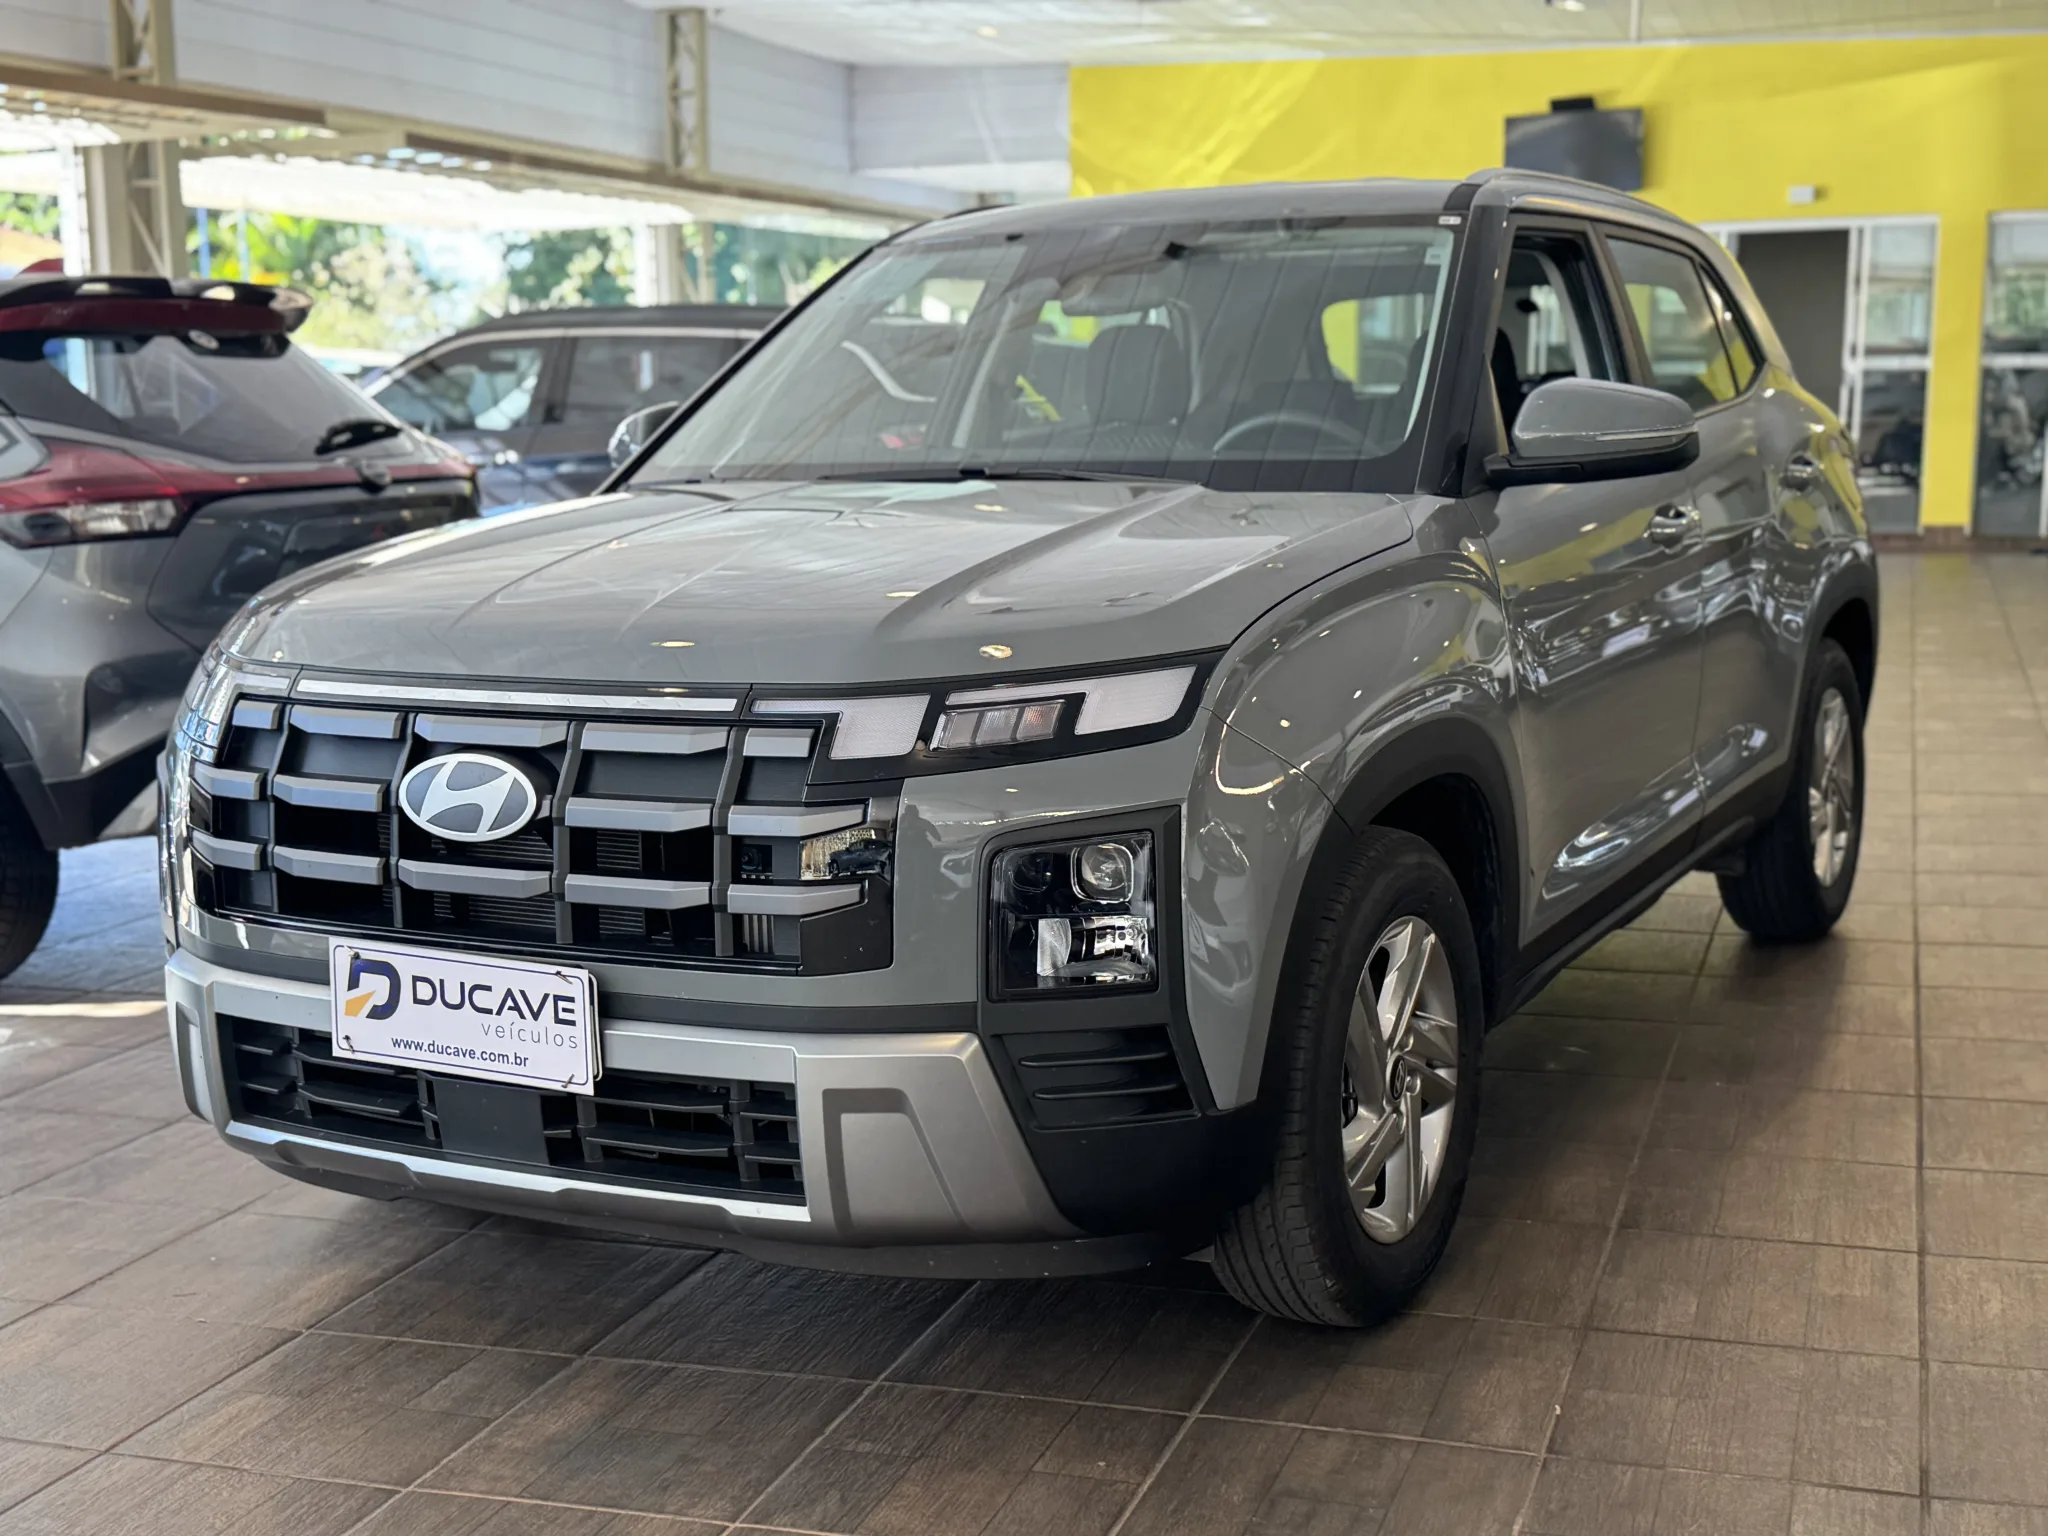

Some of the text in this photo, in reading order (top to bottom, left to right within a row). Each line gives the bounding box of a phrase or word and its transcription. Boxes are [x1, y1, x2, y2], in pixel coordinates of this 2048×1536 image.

[411, 974, 577, 1027] DUCAVE
[481, 1021, 578, 1049] veículos
[391, 1037, 529, 1068] www.ducave.com.br
